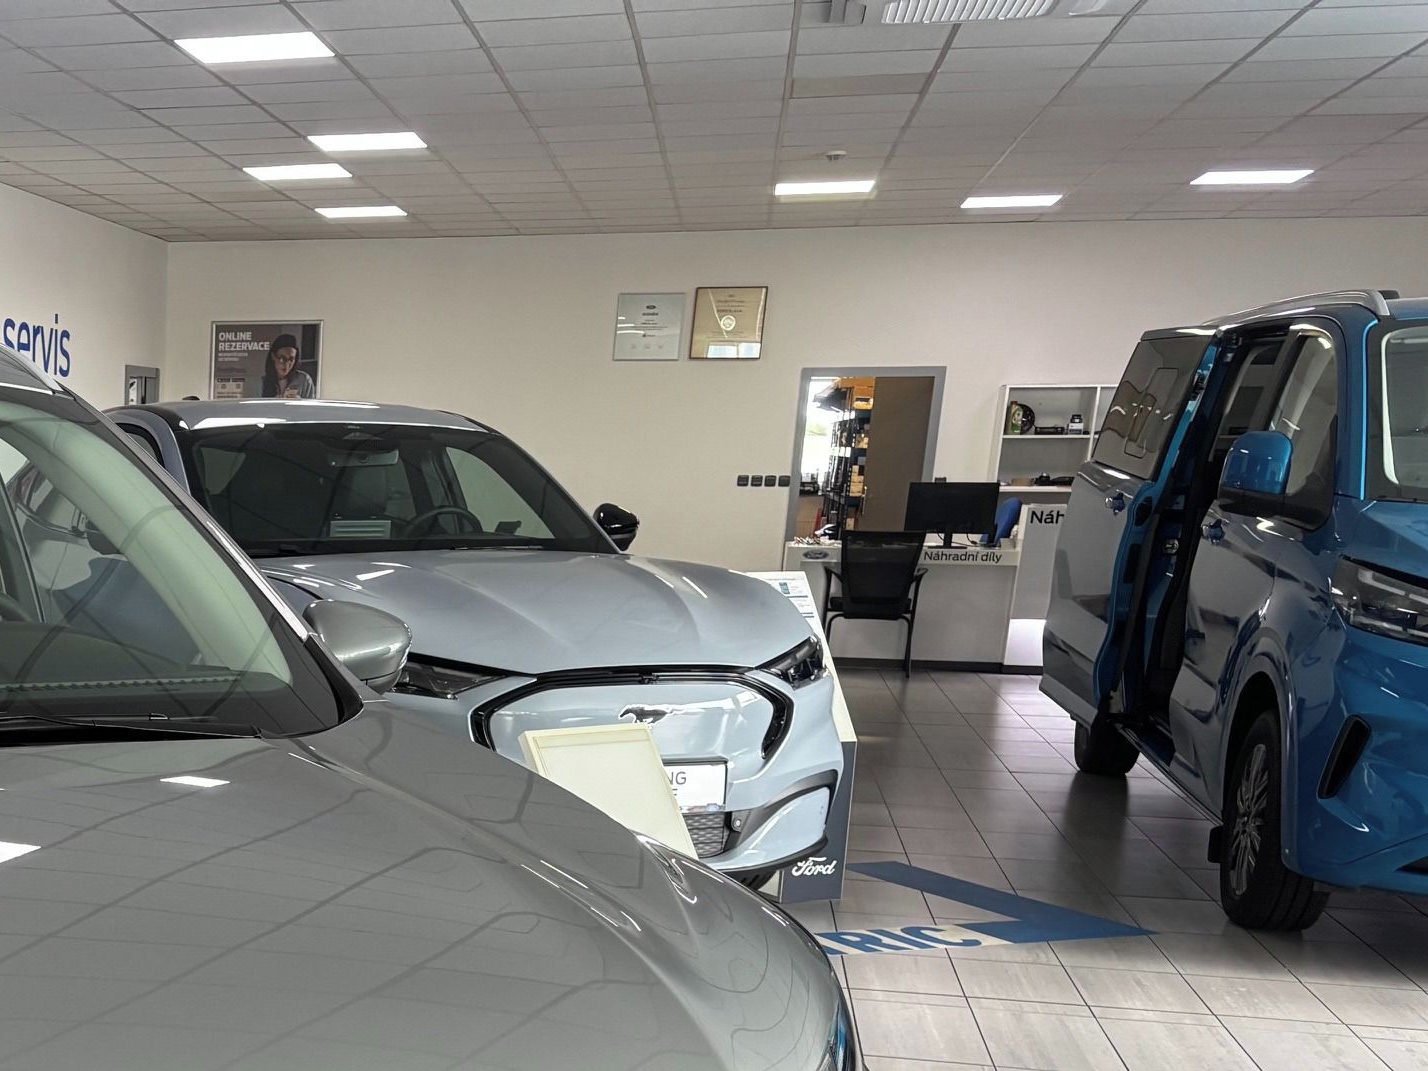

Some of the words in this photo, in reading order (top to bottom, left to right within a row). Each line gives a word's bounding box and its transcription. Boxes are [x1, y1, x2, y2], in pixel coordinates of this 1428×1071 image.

[218, 331, 253, 341] ONLINE
[3, 313, 71, 378] servis
[218, 341, 271, 351] REZERVACE
[923, 551, 979, 562] Náhradní
[980, 551, 1003, 564] díly
[791, 856, 838, 877] Ford
